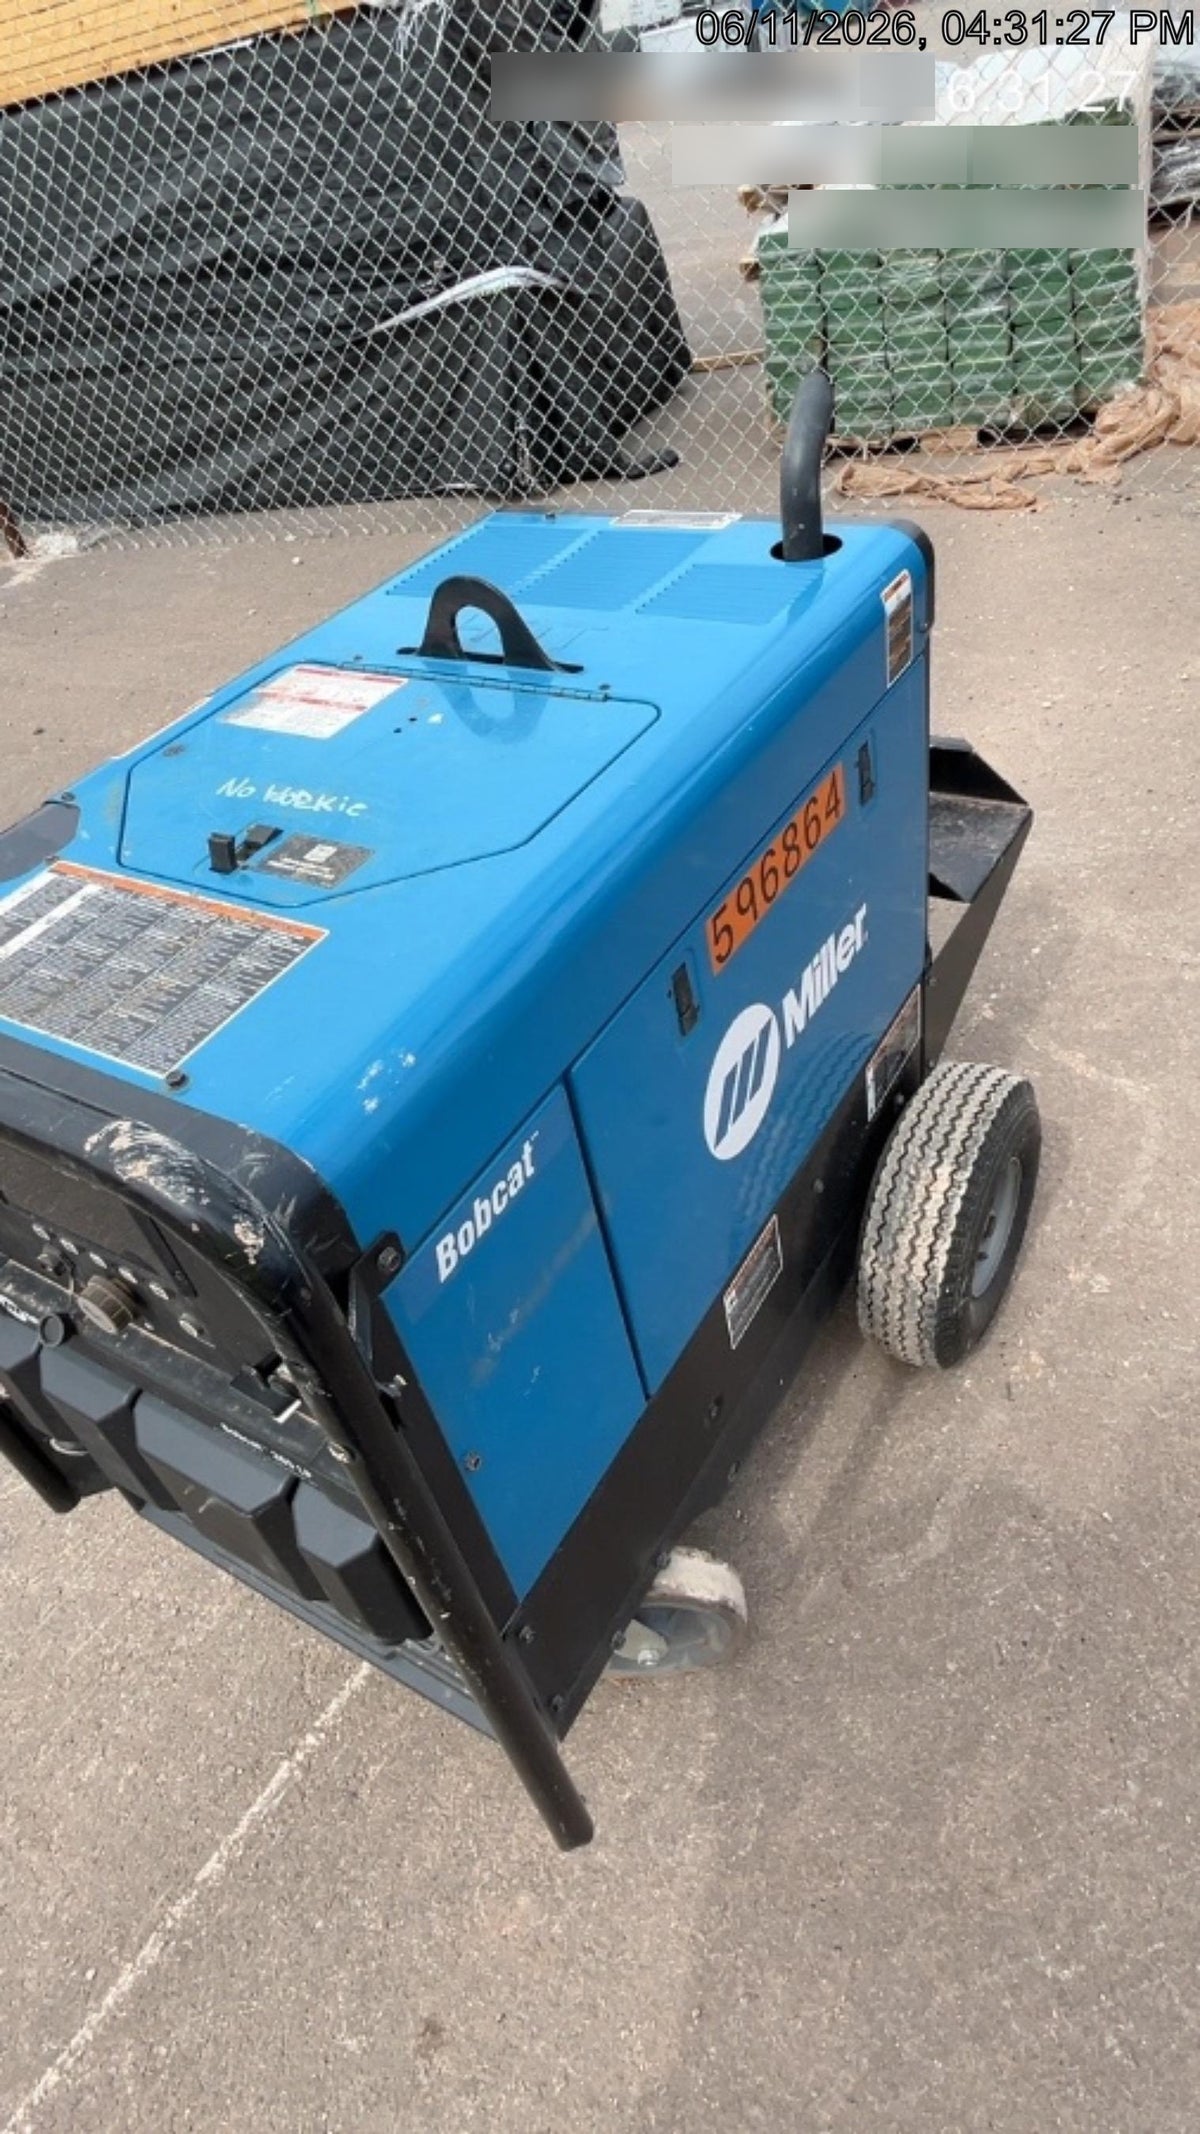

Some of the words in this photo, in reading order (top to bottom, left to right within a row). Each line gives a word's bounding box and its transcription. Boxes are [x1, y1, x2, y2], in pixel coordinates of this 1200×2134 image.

[216, 777, 256, 798] No
[710, 771, 841, 964] 596864
[782, 903, 868, 1049] Miller
[435, 1139, 535, 1284] Bobcat
